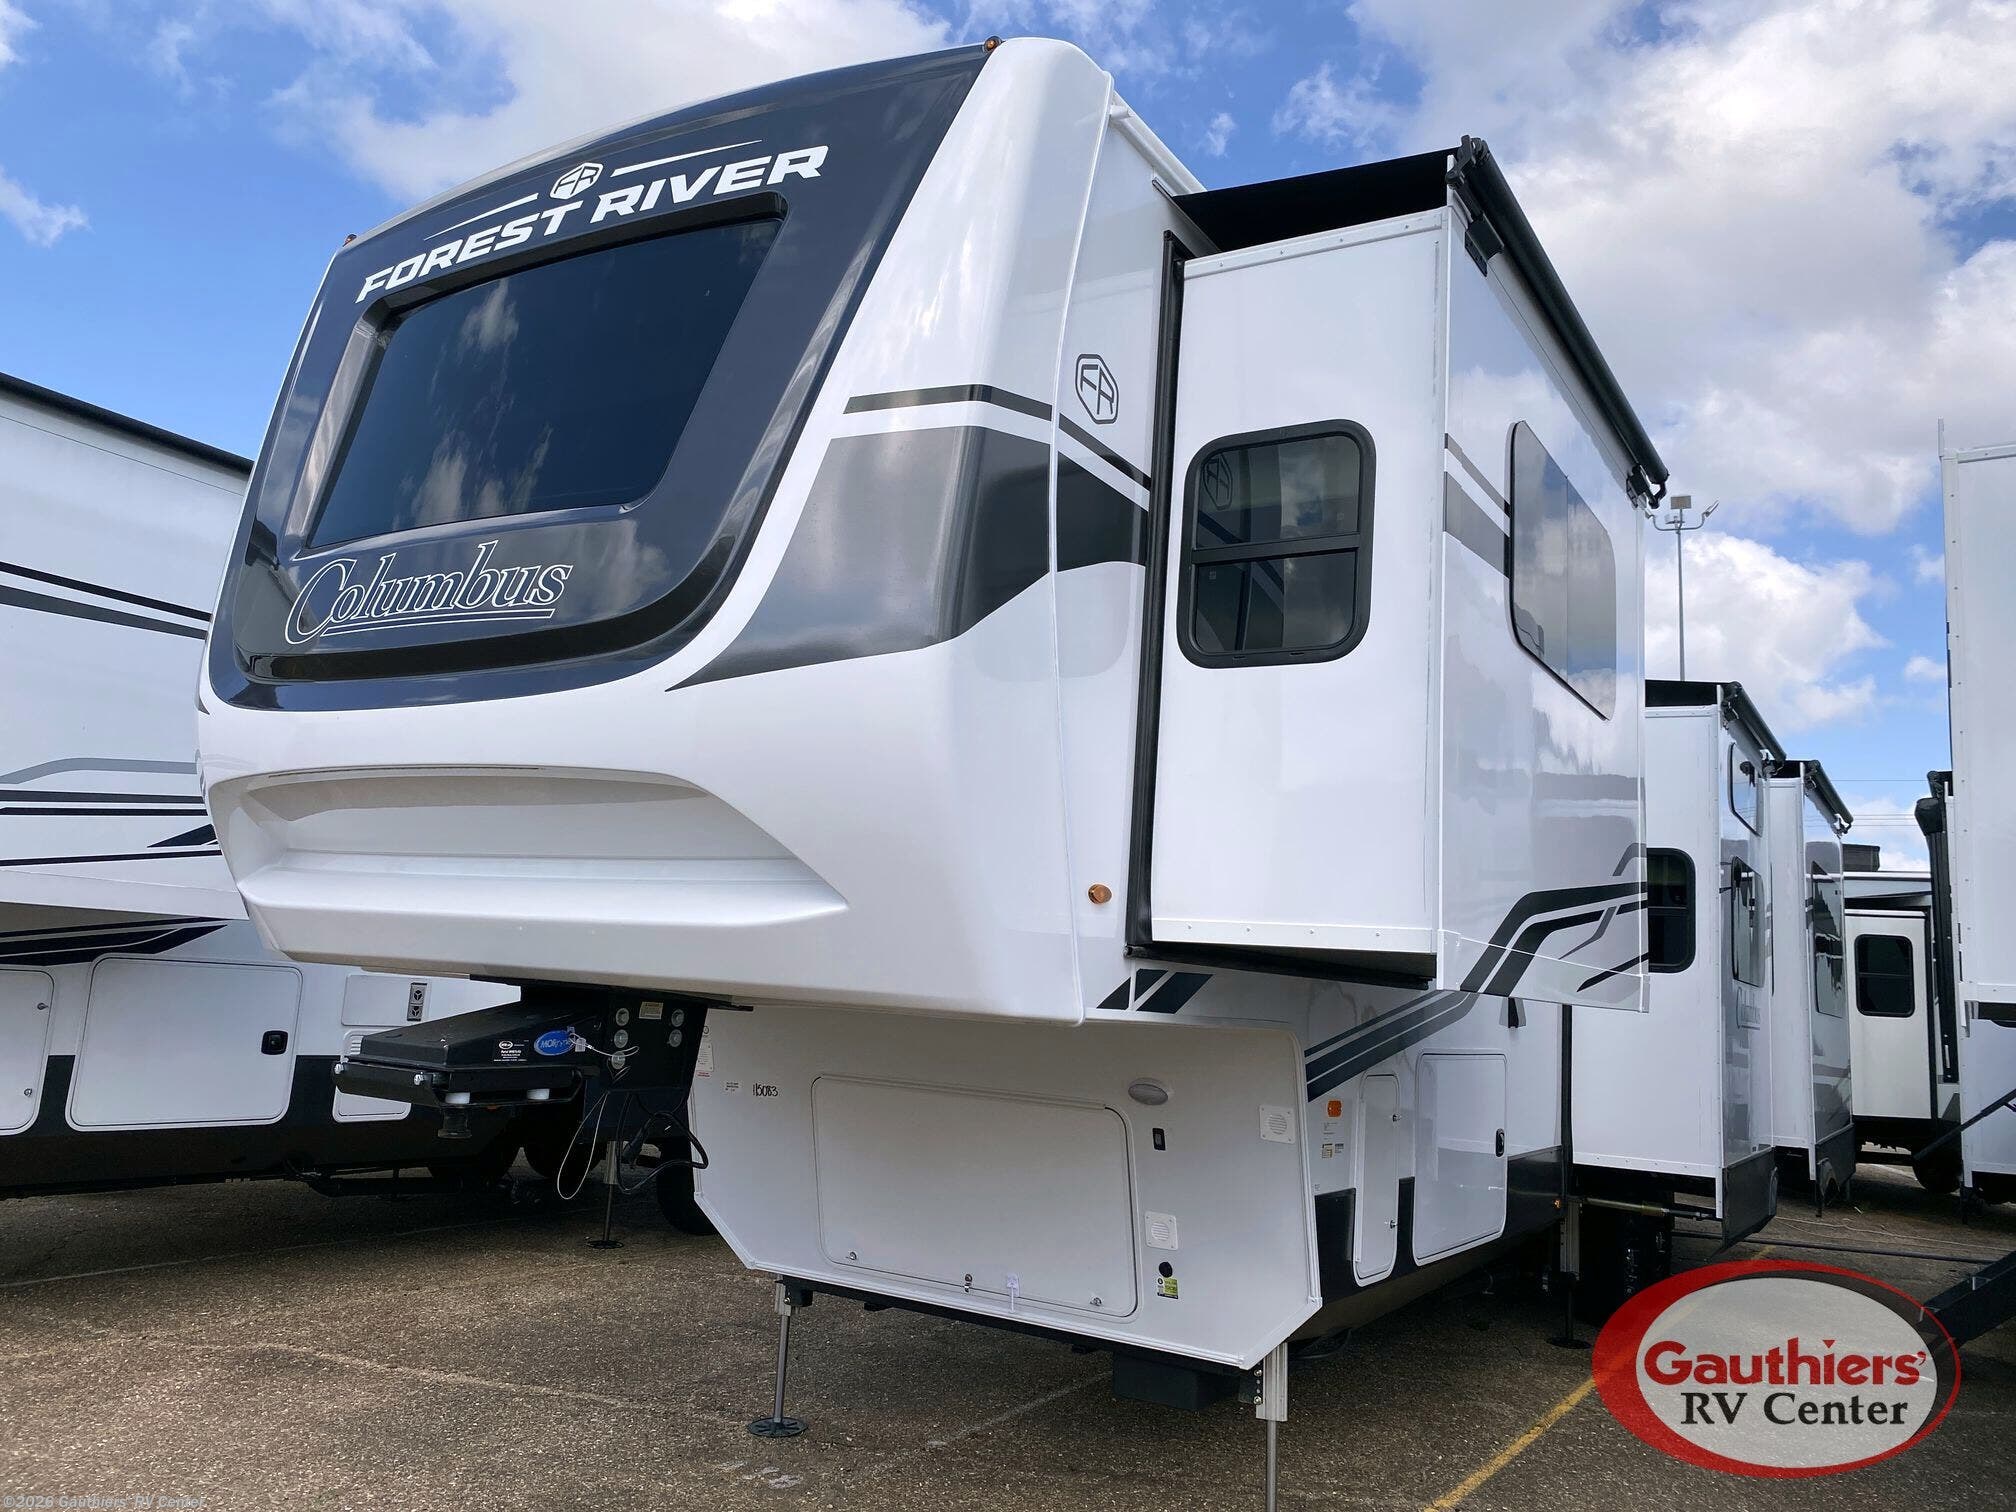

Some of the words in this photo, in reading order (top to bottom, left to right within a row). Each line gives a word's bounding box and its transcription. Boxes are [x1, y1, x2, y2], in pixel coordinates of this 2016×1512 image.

[355, 201, 584, 304] FOREST
[589, 145, 829, 224] RIVER
[284, 539, 574, 645] Columbus
